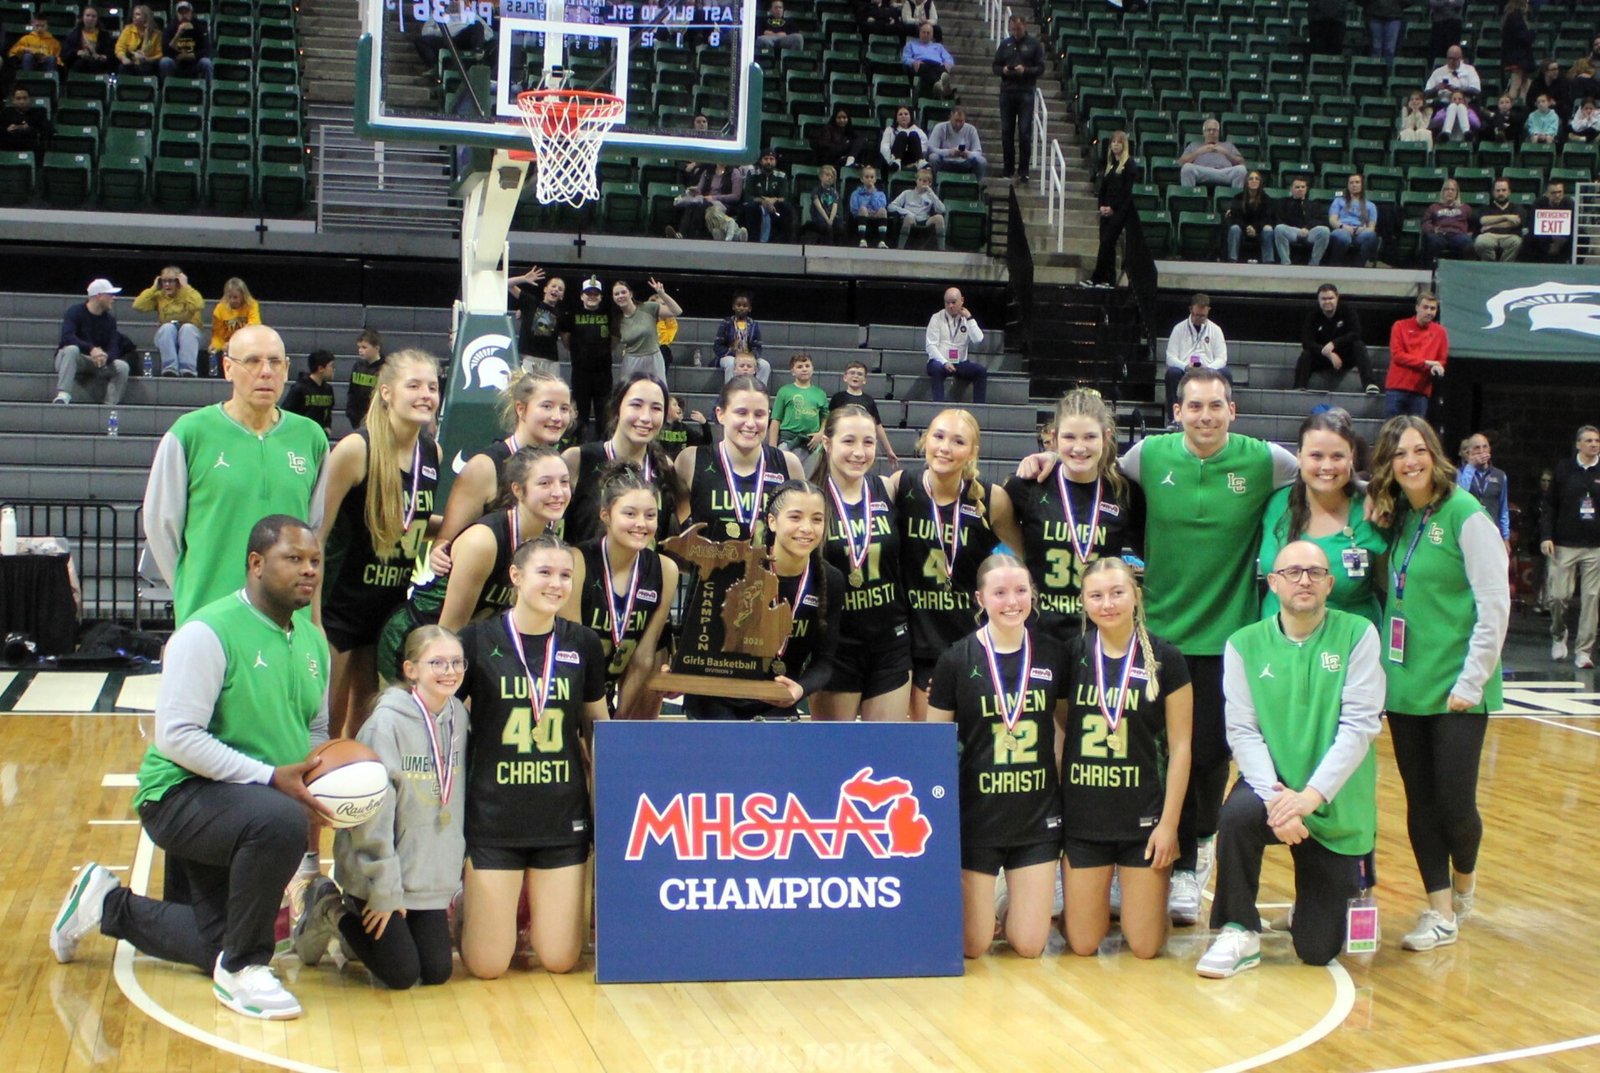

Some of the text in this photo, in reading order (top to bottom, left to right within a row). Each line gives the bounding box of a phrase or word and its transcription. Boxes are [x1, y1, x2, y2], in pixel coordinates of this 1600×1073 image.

[1536, 211, 1570, 219] EMERGENCY
[1541, 220, 1564, 233] EXIT
[1227, 472, 1246, 493] LC
[841, 583, 895, 612] HRISTI
[907, 589, 970, 611] CHRISTI
[1040, 592, 1084, 614] CHRIS
[698, 582, 715, 651] CHAMPION
[682, 655, 757, 670] Girls Basketball
[1320, 652, 1342, 673] LC
[501, 706, 565, 754] 40
[991, 718, 1039, 766] 12
[1080, 713, 1129, 760] 21
[496, 760, 570, 785] CHRISTI
[978, 768, 1046, 794] CHRISTI
[1069, 762, 1140, 788] CHRISTI
[624, 792, 891, 861] MHSAA
[659, 876, 902, 911] CHAMPIONS
